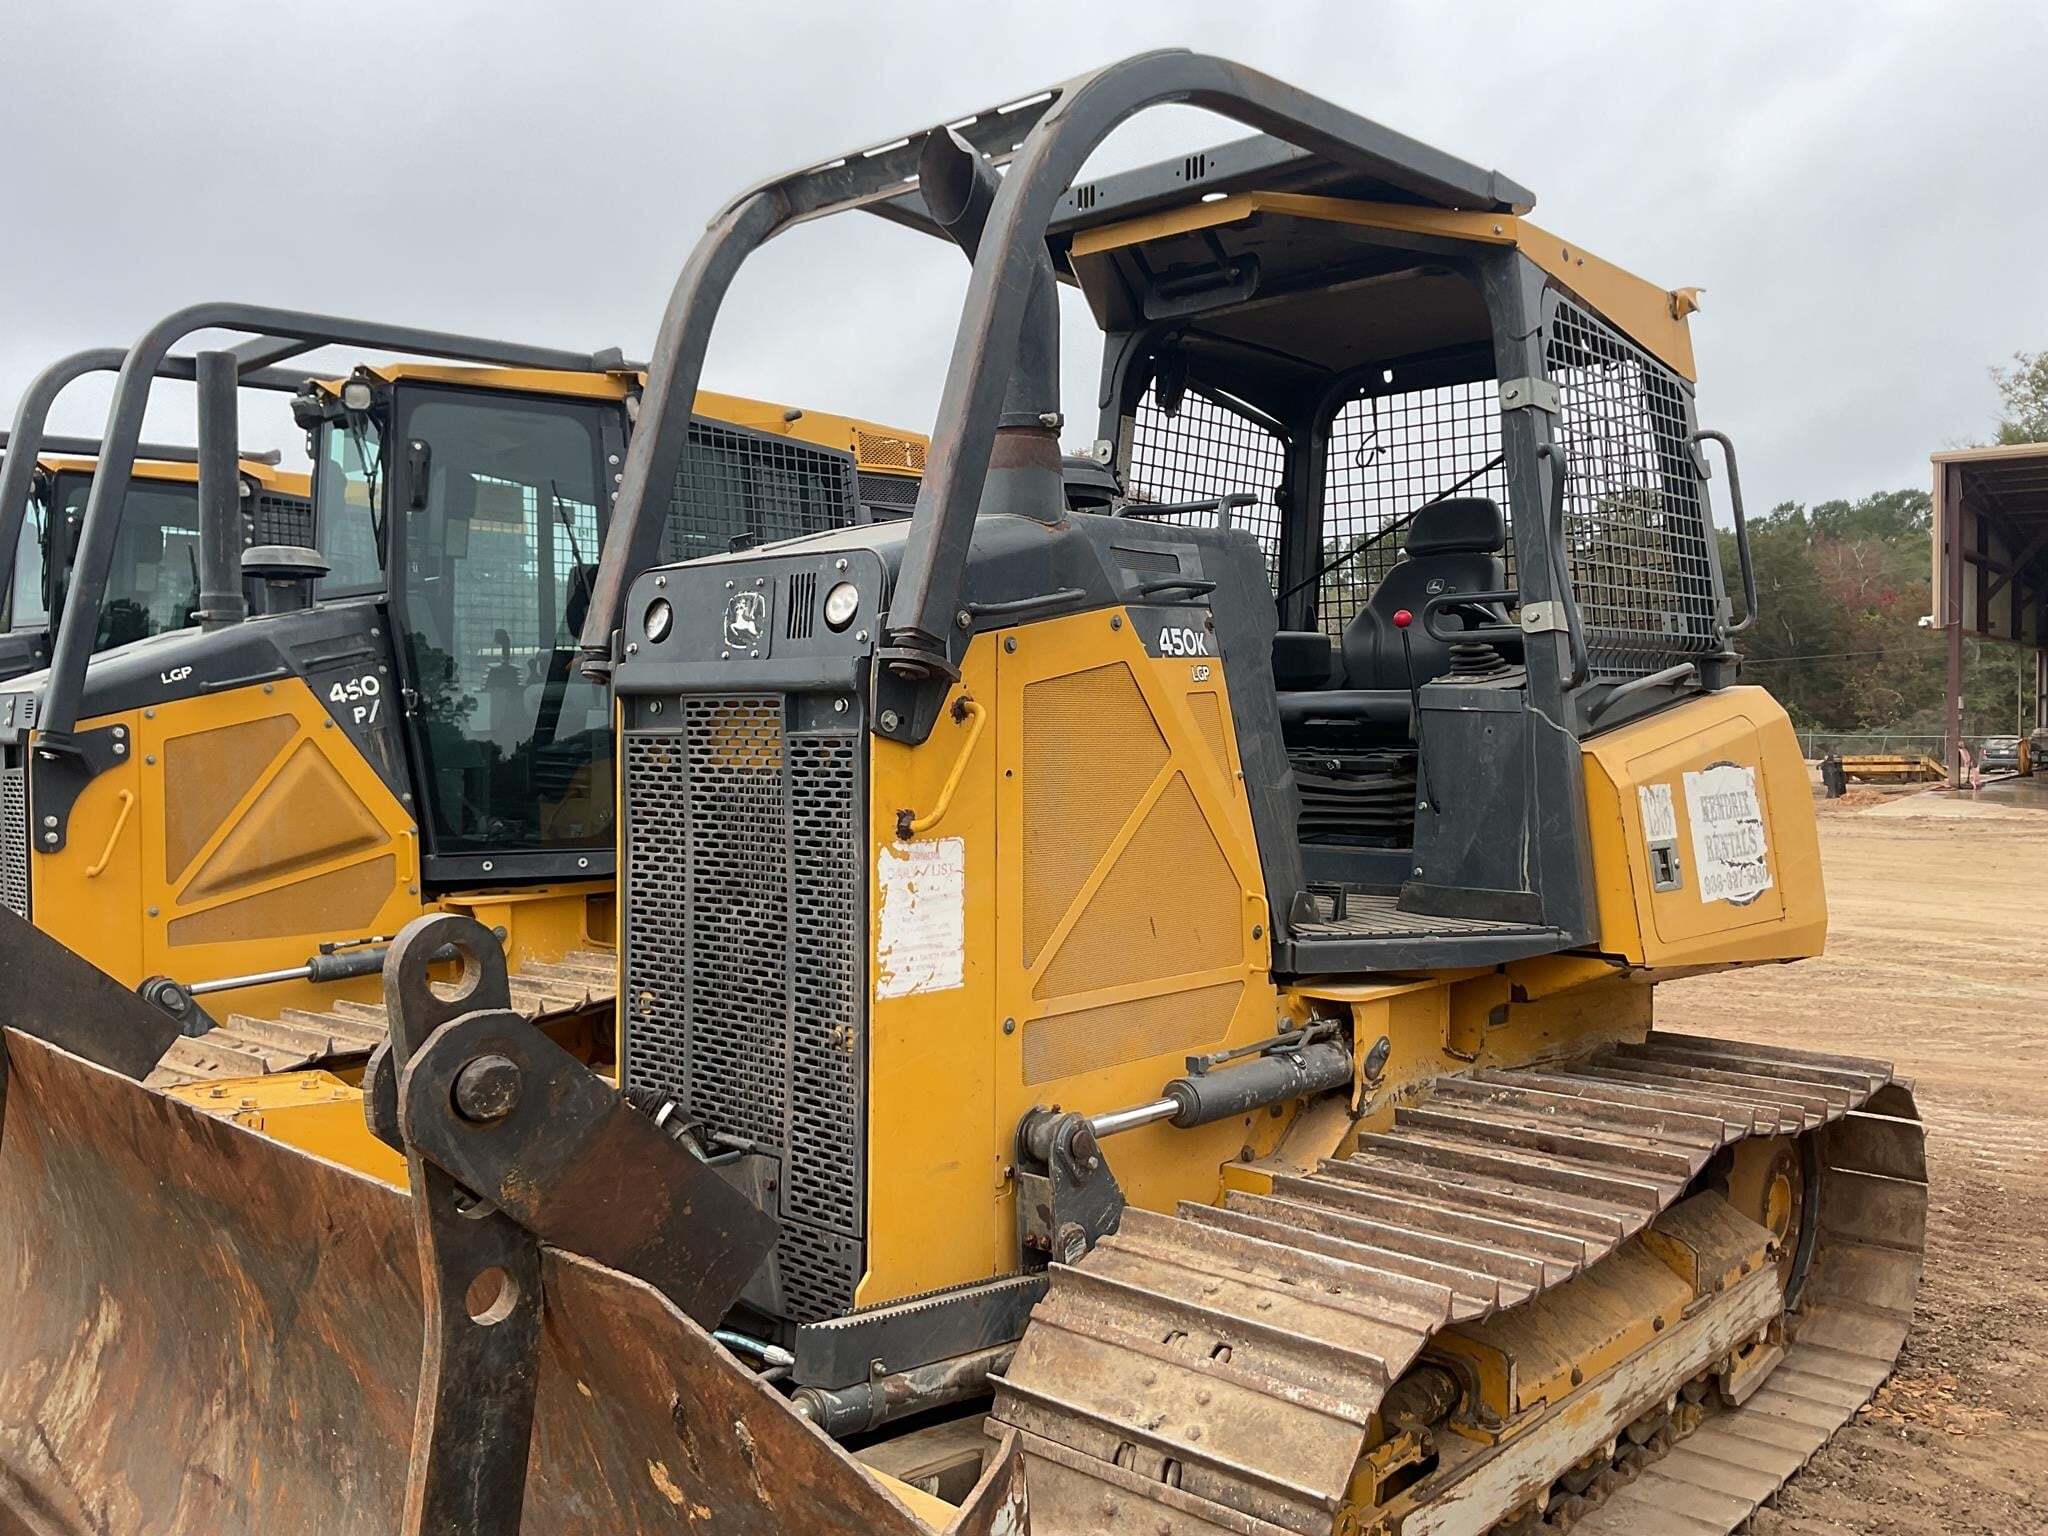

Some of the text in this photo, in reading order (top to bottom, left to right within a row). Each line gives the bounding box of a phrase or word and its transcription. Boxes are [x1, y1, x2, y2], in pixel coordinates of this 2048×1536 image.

[1159, 627, 1209, 656] 450K
[160, 666, 193, 684] LGP
[1191, 665, 1210, 682] LGP
[329, 675, 380, 703] 450
